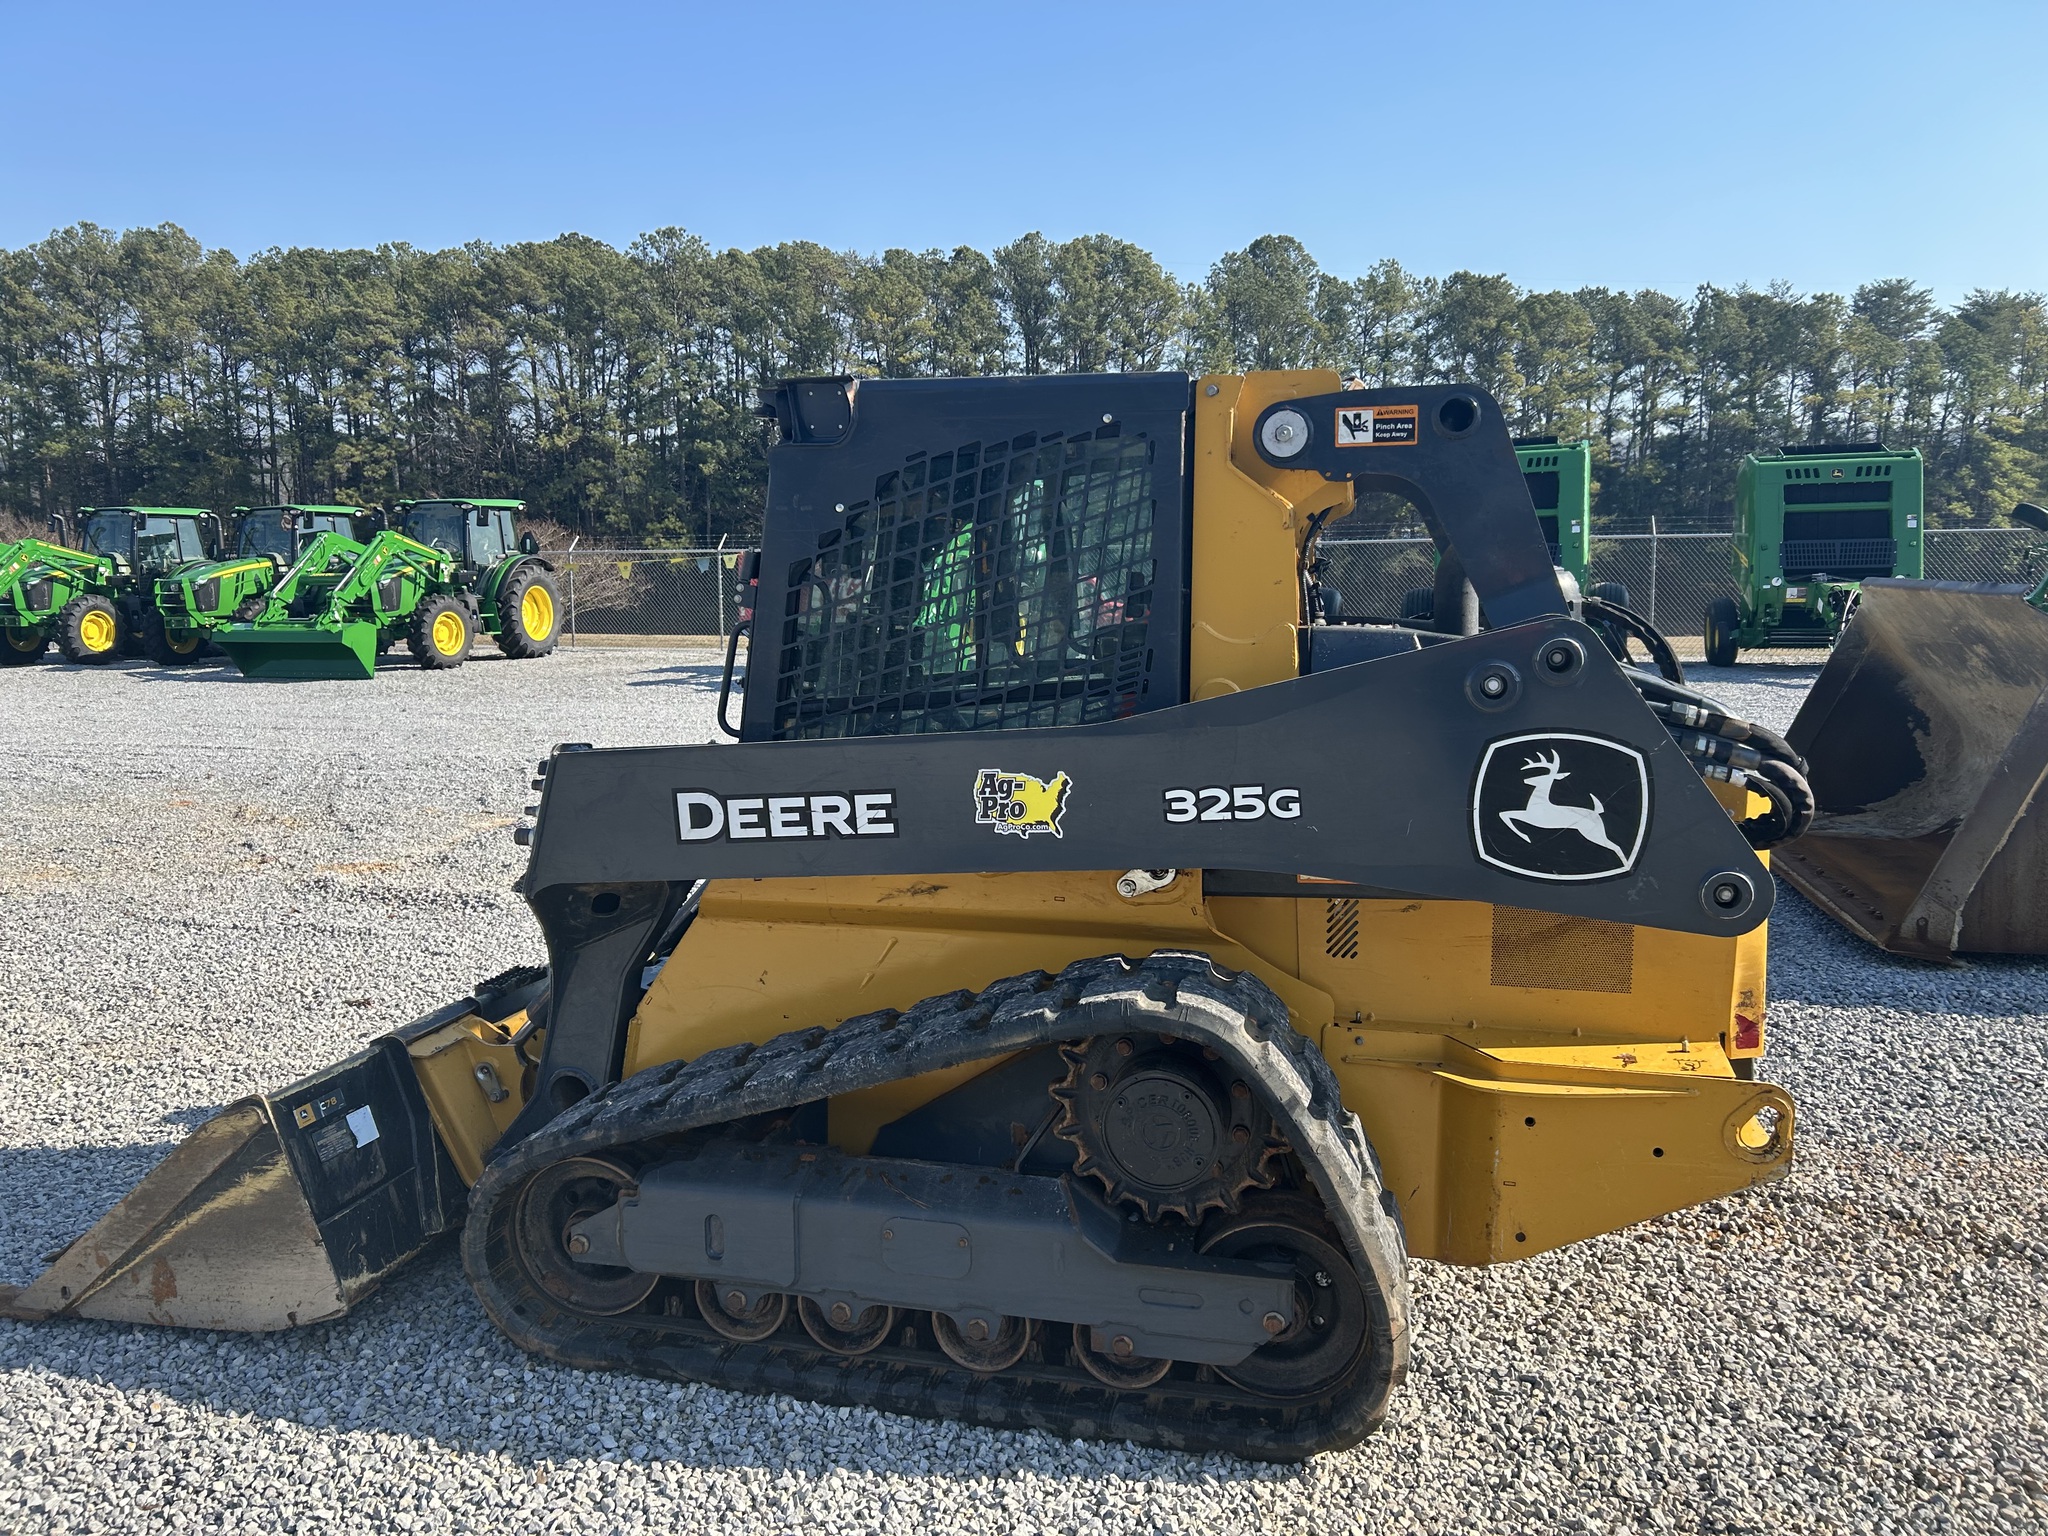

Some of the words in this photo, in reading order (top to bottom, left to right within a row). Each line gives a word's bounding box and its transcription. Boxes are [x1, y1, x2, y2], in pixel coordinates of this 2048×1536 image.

[676, 792, 895, 841] DEERE
[979, 796, 1026, 820] Pro
[1164, 786, 1301, 822] 325G
[997, 822, 1050, 832] AgProCo.com
